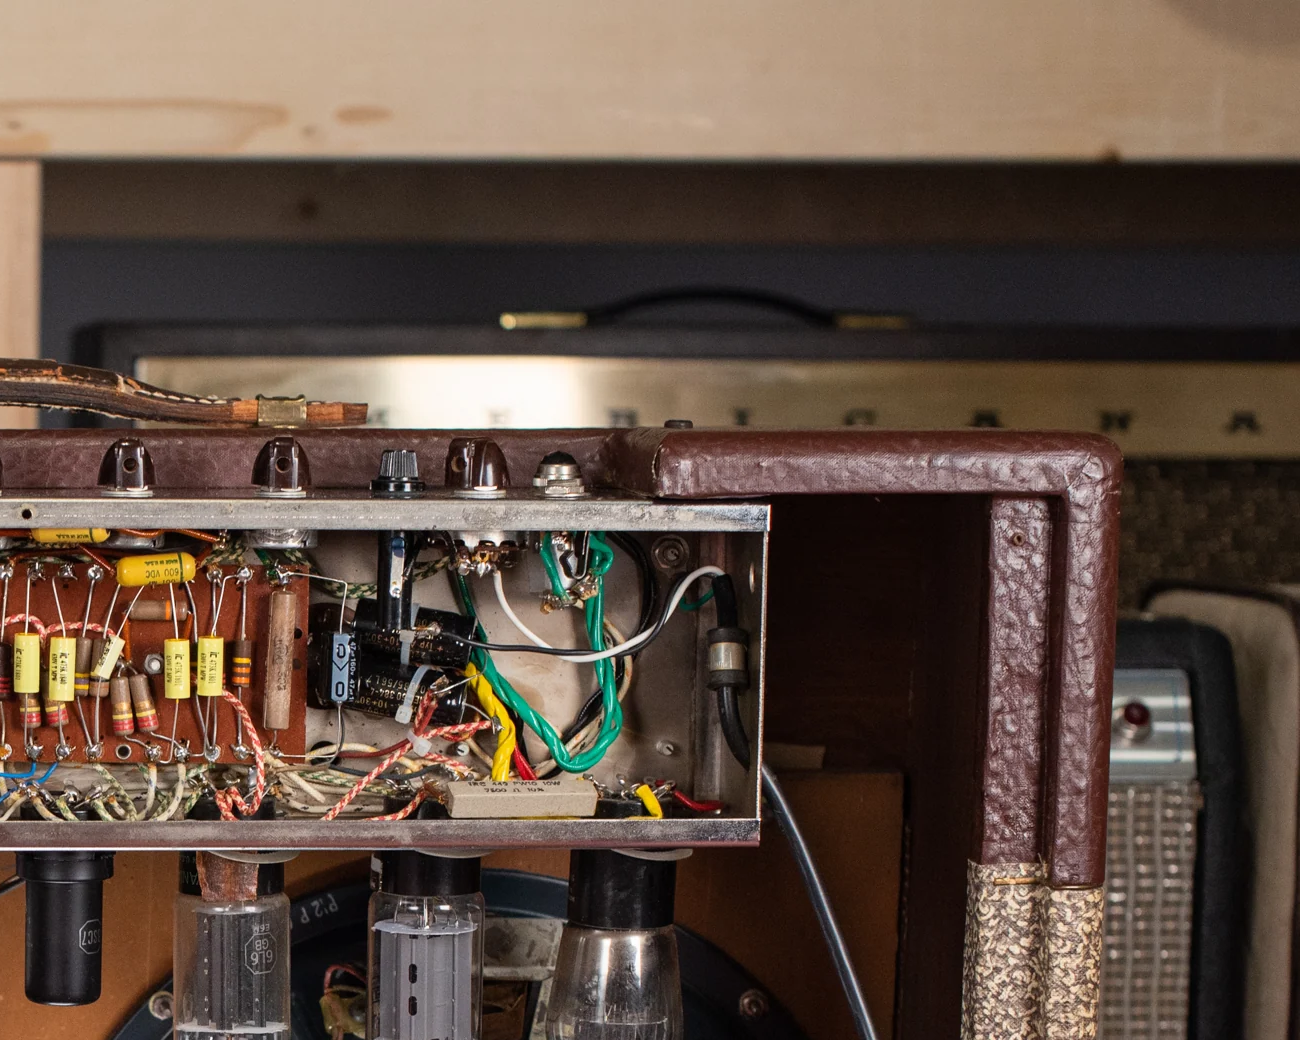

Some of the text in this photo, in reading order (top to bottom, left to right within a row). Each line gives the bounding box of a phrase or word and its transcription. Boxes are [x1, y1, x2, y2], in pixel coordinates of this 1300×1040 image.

[145, 568, 179, 579] 600 VDC
[300, 907, 311, 925] P
[255, 938, 269, 951] GB
[250, 950, 273, 966] 6L6
